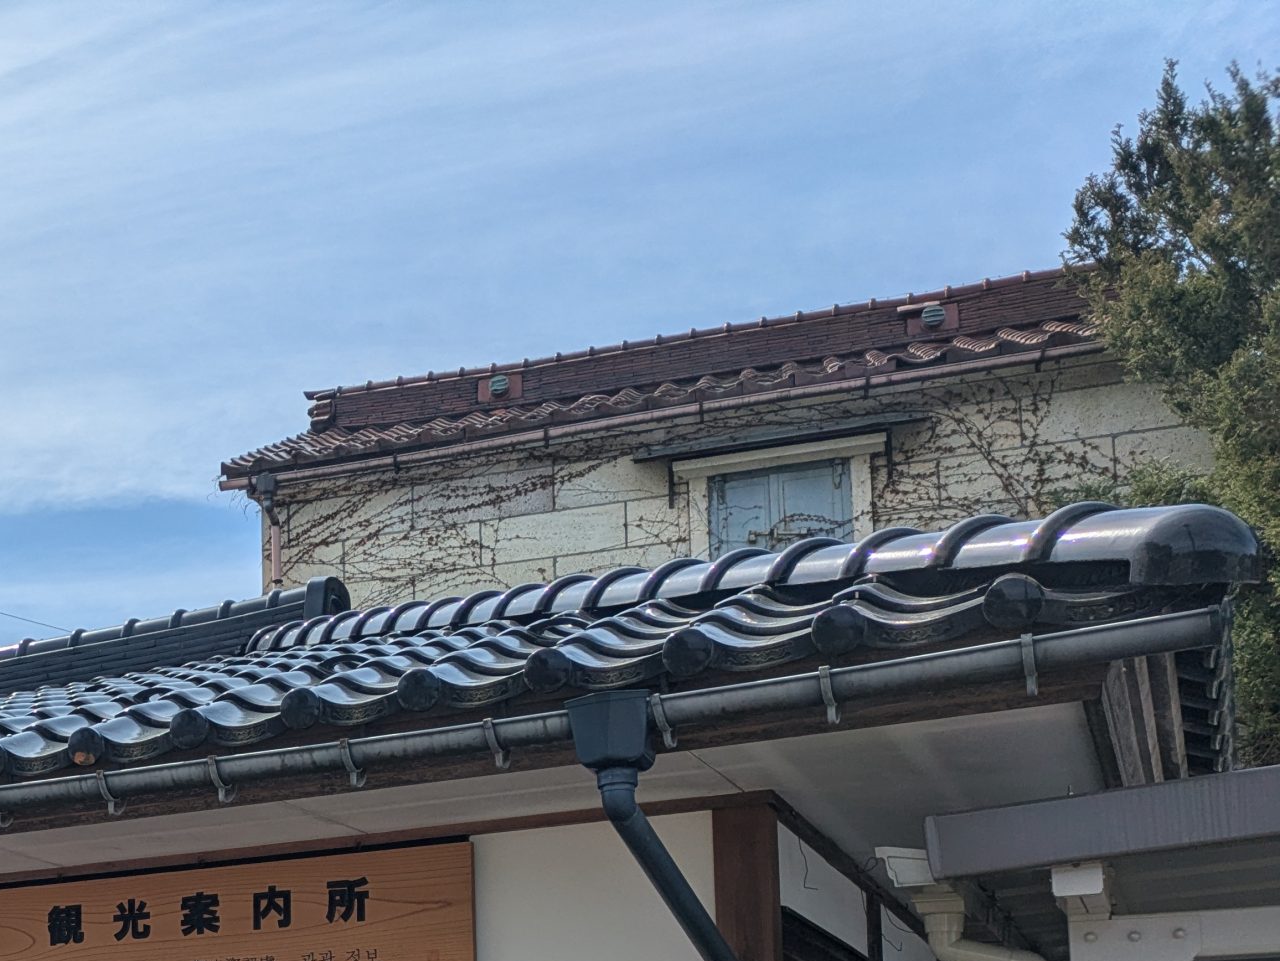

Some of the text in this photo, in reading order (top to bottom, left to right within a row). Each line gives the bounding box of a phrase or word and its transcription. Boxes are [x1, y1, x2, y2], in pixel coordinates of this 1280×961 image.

[48, 876, 370, 945] 観光案内所
